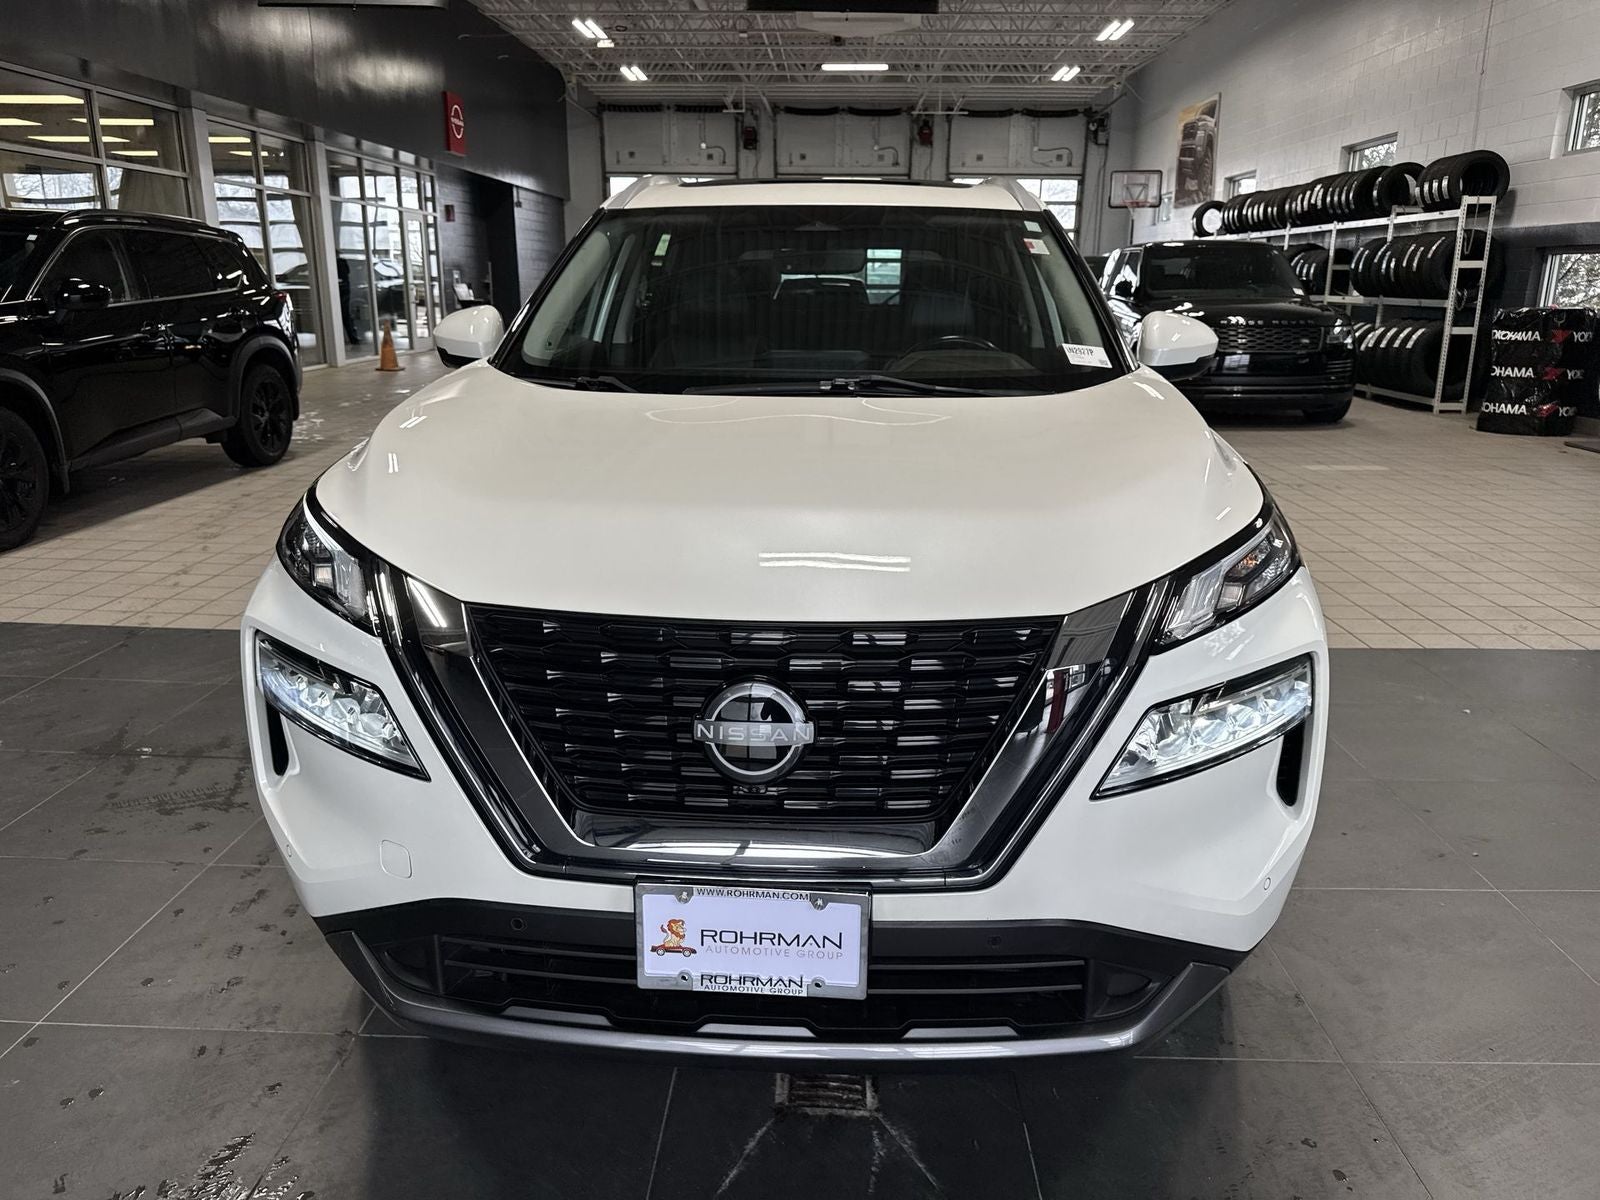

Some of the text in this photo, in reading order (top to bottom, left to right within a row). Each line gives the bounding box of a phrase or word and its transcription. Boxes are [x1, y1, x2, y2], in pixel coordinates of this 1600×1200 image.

[697, 723, 811, 742] NISSAN
[696, 888, 810, 901] WWW.ROHRMAN.COM
[700, 929, 843, 949] ROHRMAN
[705, 944, 844, 960] AUTOMOTIVE GROUP
[700, 973, 803, 989] ROHRMAN
[704, 983, 804, 996] AUTOMOTIVE GROUP
